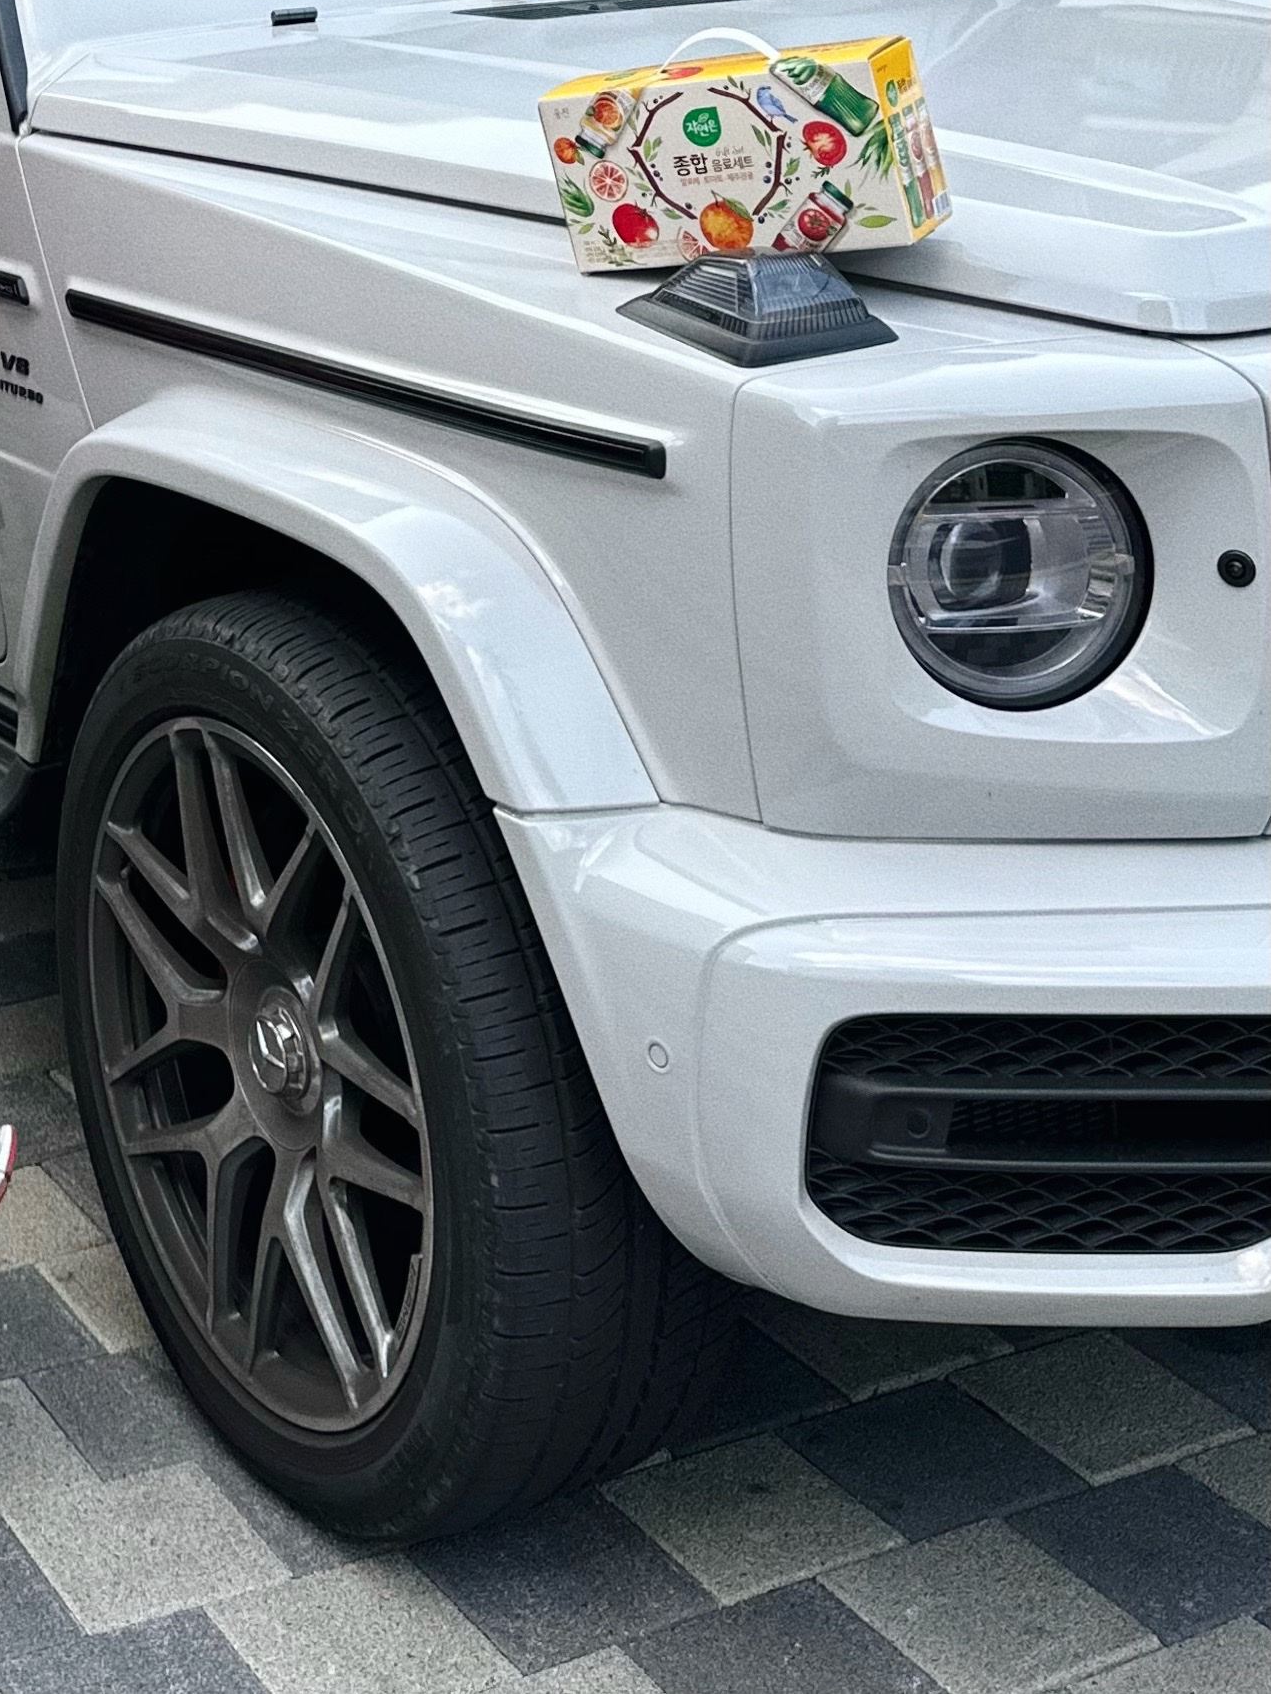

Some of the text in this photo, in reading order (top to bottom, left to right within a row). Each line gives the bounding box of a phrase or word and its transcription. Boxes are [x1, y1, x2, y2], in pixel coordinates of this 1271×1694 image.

[673, 152, 755, 177] 종합 음료세트
[0, 351, 30, 376] V8
